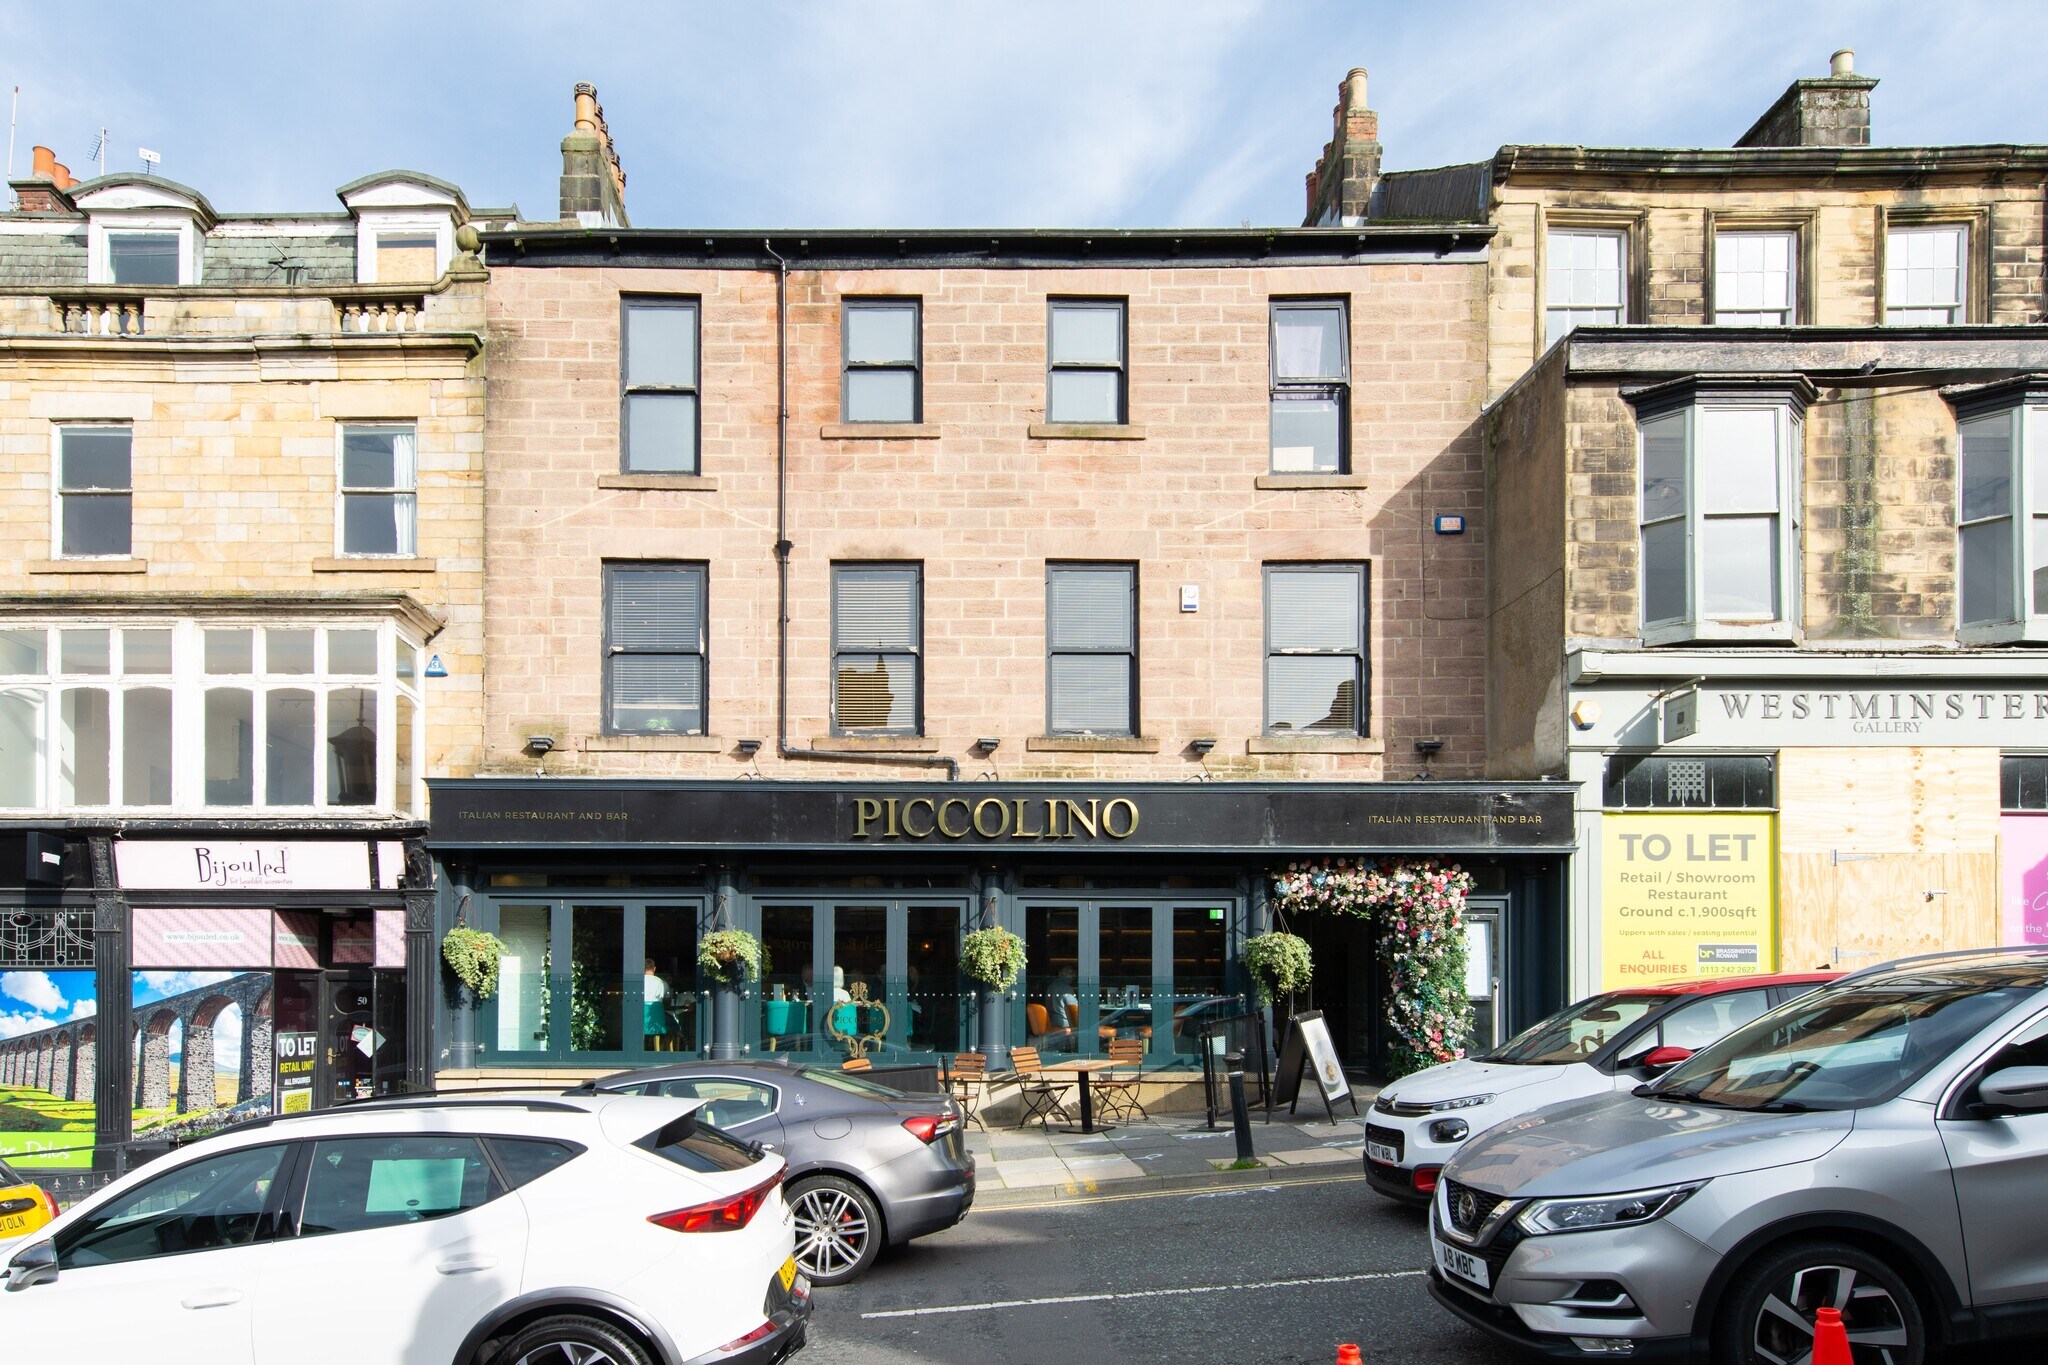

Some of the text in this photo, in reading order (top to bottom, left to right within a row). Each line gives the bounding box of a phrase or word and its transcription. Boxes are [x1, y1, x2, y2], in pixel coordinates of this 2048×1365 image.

[1719, 693, 2048, 720] WESTMINSTER
[1853, 721, 1923, 734] GALLERY
[458, 811, 628, 820] ITALIAN RESTAURANT AND BAR
[853, 798, 1139, 838] PICCOLINO
[1368, 815, 1542, 824] ITALIAN RESTAURANT AND BAR
[1619, 834, 1756, 861] TO LET
[193, 847, 287, 886] Bijouled
[1620, 872, 1662, 883] Retail
[1676, 872, 1755, 883] Showroom
[1648, 889, 1728, 900] Restaurant
[1619, 906, 1757, 919] Ground c.1,900sqft
[2025, 923, 2042, 933] the
[166, 932, 240, 942] www.bijouled.co.uk
[1642, 950, 1665, 959] ALL
[1620, 964, 1687, 974] ENQUIRIES
[357, 996, 368, 1006] 50
[279, 1037, 316, 1058] TO LET
[280, 1060, 315, 1073] RETAIL UNIT
[286, 1094, 307, 1105] CARTER
[1455, 1250, 1476, 1279] MBC
